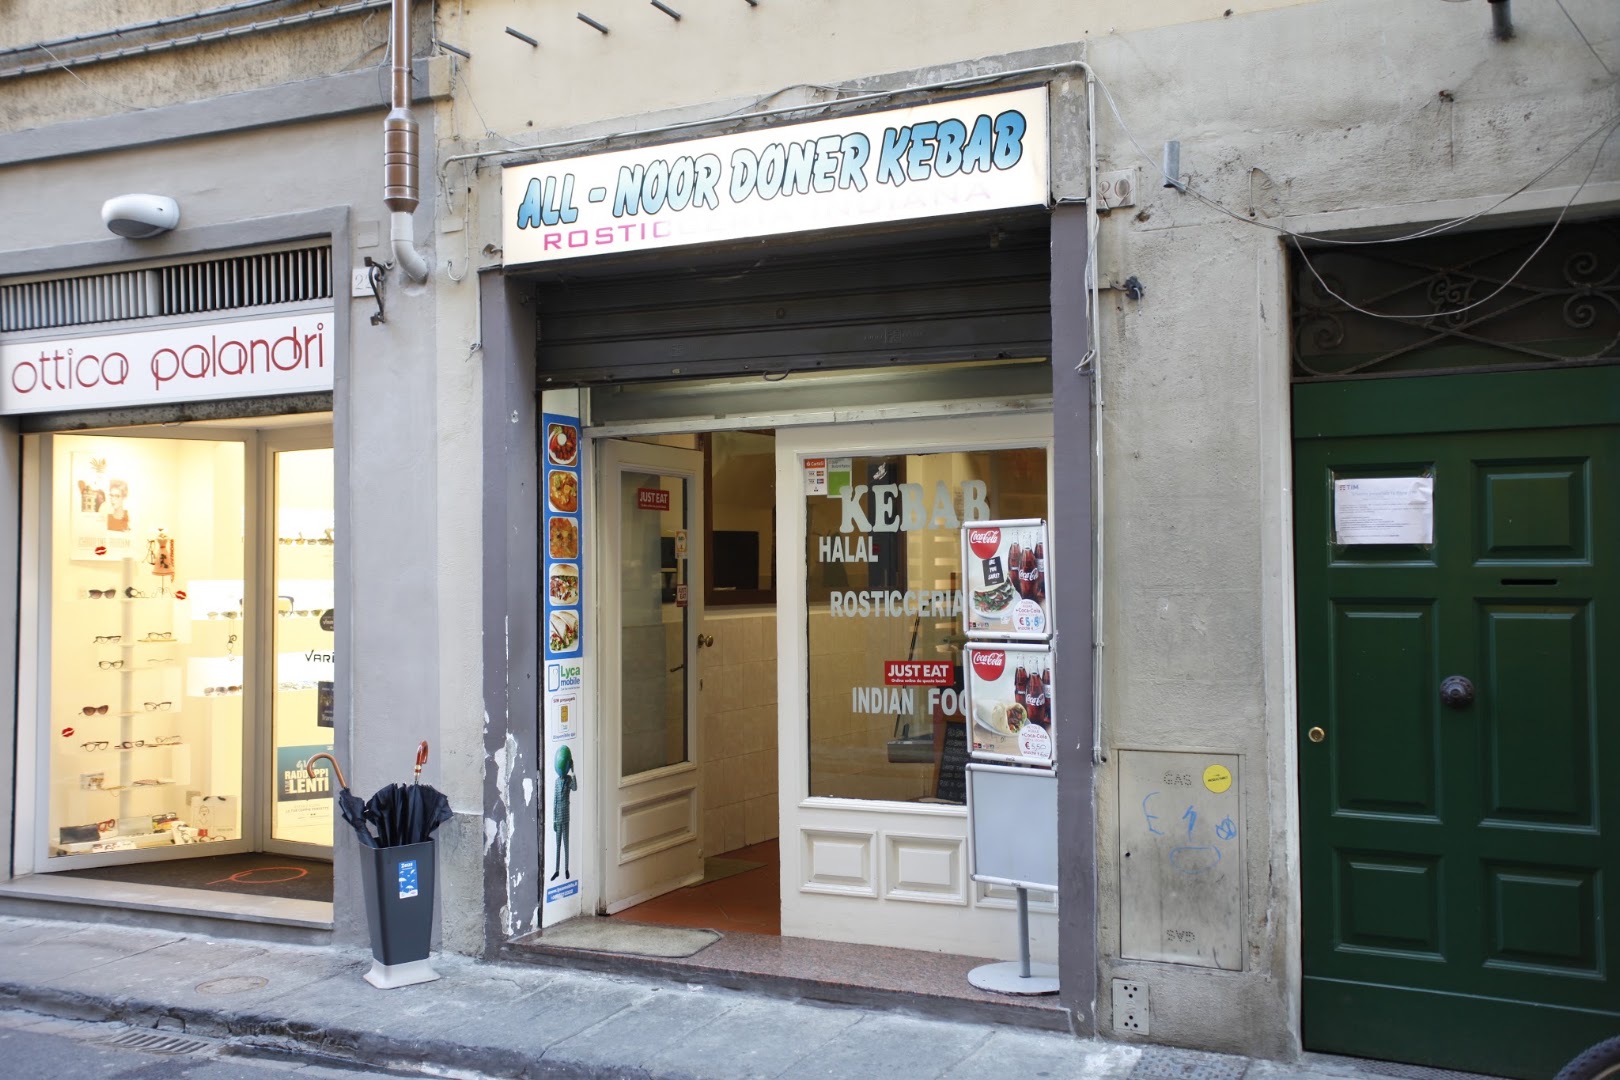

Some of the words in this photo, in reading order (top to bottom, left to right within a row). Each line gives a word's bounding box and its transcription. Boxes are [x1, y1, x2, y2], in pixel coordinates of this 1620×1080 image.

[516, 173, 579, 230] ALL
[612, 151, 721, 217] NOOR
[728, 131, 871, 204] DONER
[876, 109, 1028, 189] KEBAB
[11, 347, 130, 394] ottica
[150, 322, 325, 391] palandri
[640, 491, 655, 503] JUST
[655, 493, 668, 504] EAT
[839, 479, 991, 533] KEBAB
[818, 535, 879, 563] HALAL
[830, 590, 963, 618] ROSTICCERIA
[561, 665, 580, 679] Lyca
[561, 676, 580, 687] mobile
[888, 664, 921, 677] JUST
[923, 664, 949, 677] EAT
[852, 686, 914, 715] INDIAN
[285, 767, 329, 780] RADDPPI
[289, 777, 330, 794] LENTI
